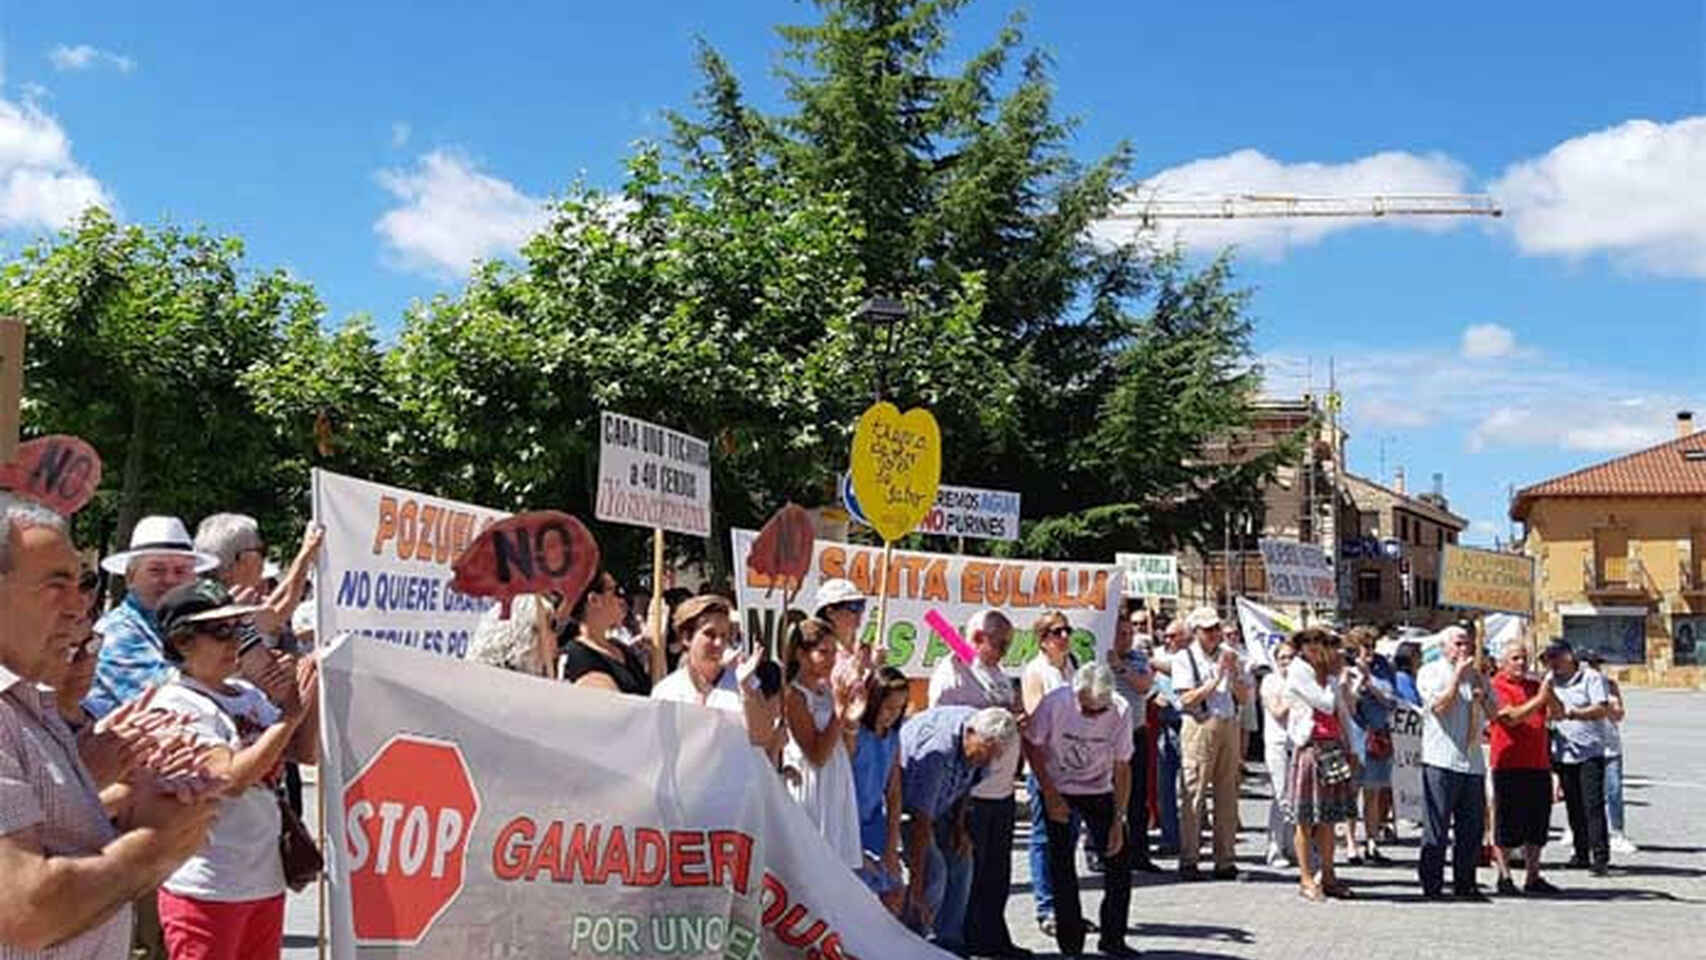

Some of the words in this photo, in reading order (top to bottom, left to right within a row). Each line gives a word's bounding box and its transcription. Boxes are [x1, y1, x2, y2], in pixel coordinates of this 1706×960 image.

[605, 415, 638, 450] CADA
[32, 445, 92, 499] NO
[933, 488, 979, 511] REMOS
[373, 494, 492, 564] POZUEL
[945, 513, 1004, 537] PURINES
[492, 525, 572, 585] NO
[820, 546, 949, 602] SANTA
[960, 561, 1108, 611] EULALIA
[337, 570, 371, 607] NO
[375, 572, 440, 611] QUIERE
[447, 629, 469, 659] PO
[348, 802, 462, 878] STOP
[492, 816, 754, 895] GANADER
[571, 916, 641, 951] POR
